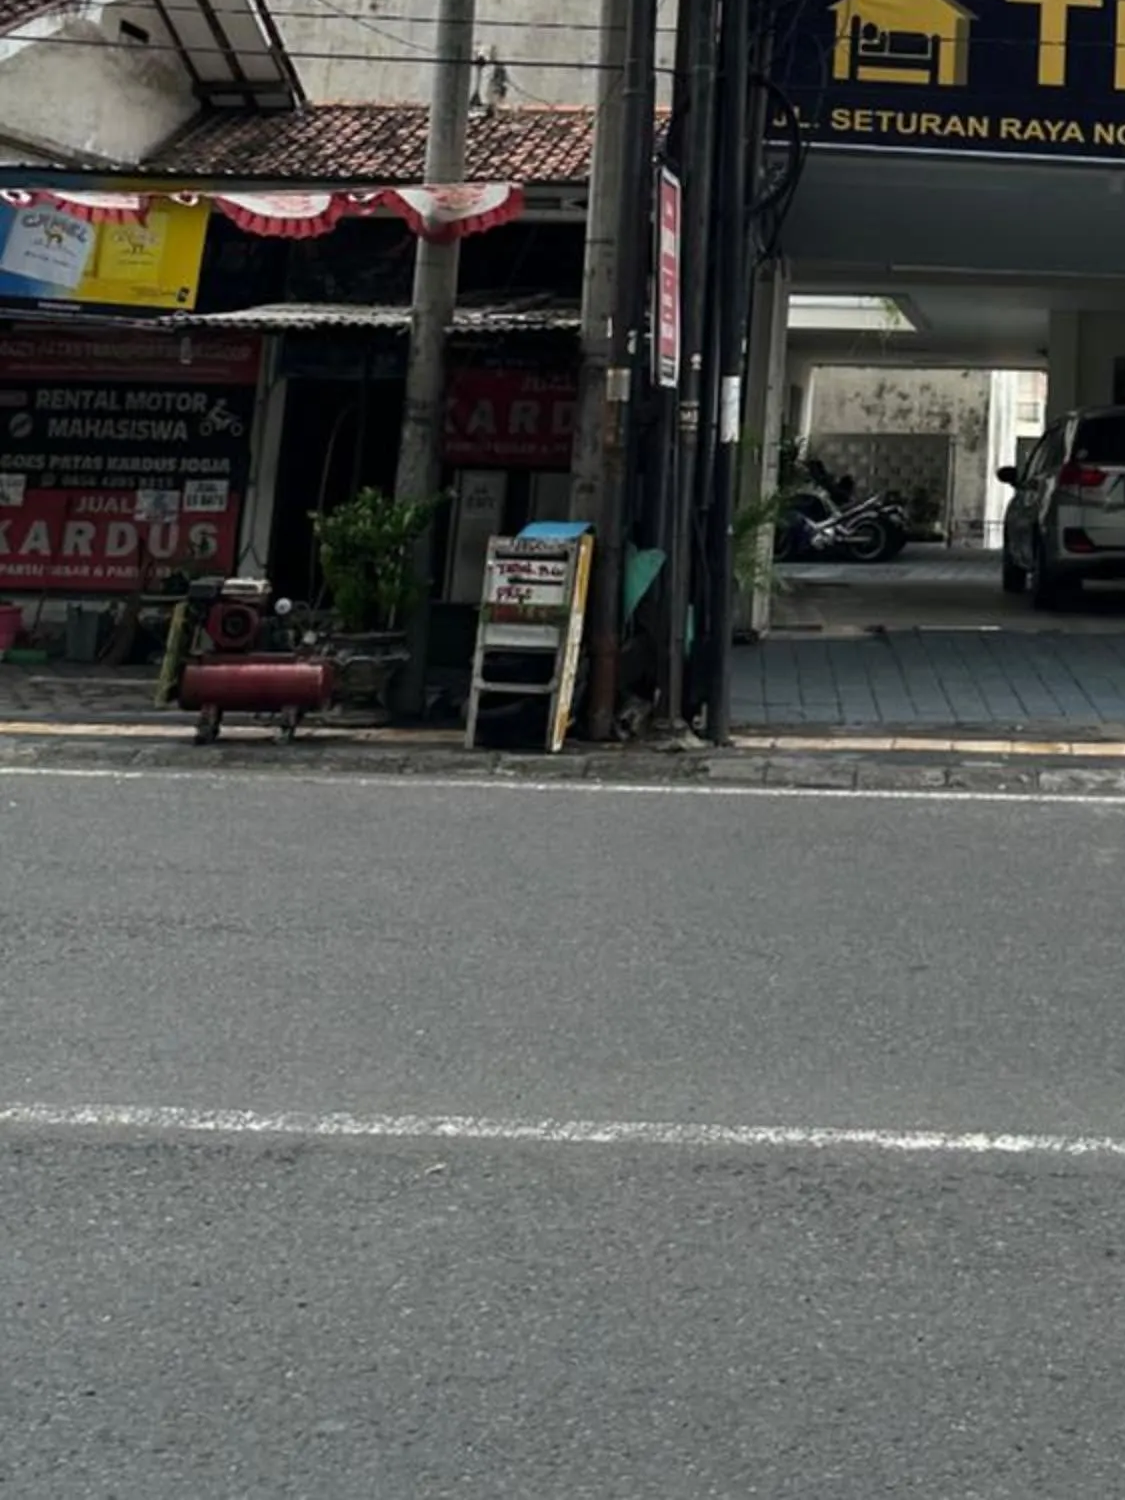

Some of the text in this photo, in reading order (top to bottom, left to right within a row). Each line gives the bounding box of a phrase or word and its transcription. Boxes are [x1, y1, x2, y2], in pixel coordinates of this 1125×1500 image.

[830, 107, 990, 139] SETURAN
[1000, 116, 1085, 144] RAYA
[22, 212, 88, 244] CAMEL
[35, 387, 208, 413] RENTAL MOTOR
[47, 417, 189, 442] MAHASISWA
[444, 398, 579, 436] KARD
[106, 456, 178, 473] KARDUS
[75, 496, 133, 514] JUAL
